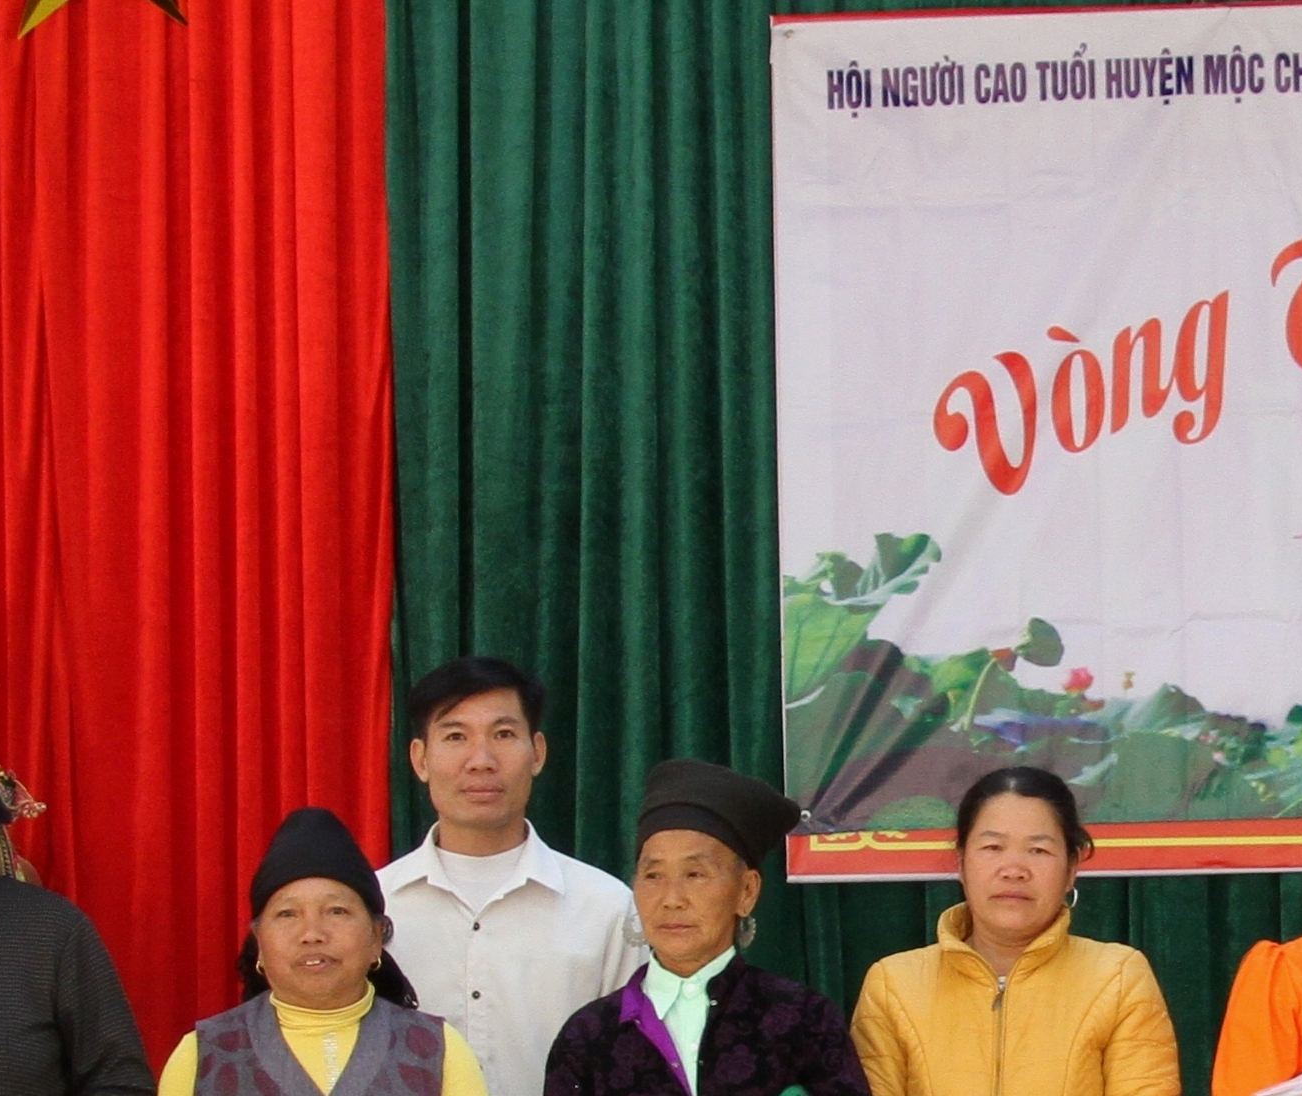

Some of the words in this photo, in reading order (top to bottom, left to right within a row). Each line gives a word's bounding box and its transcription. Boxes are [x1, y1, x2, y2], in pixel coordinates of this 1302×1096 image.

[826, 60, 872, 117] HỘI
[881, 58, 965, 108] NGƯỜI
[974, 64, 1028, 105] CAO
[1036, 43, 1096, 102] TUỔI
[1105, 48, 1195, 105] HUYỆN
[1204, 48, 1265, 104] MỘC
[933, 290, 1230, 496] Vòng
